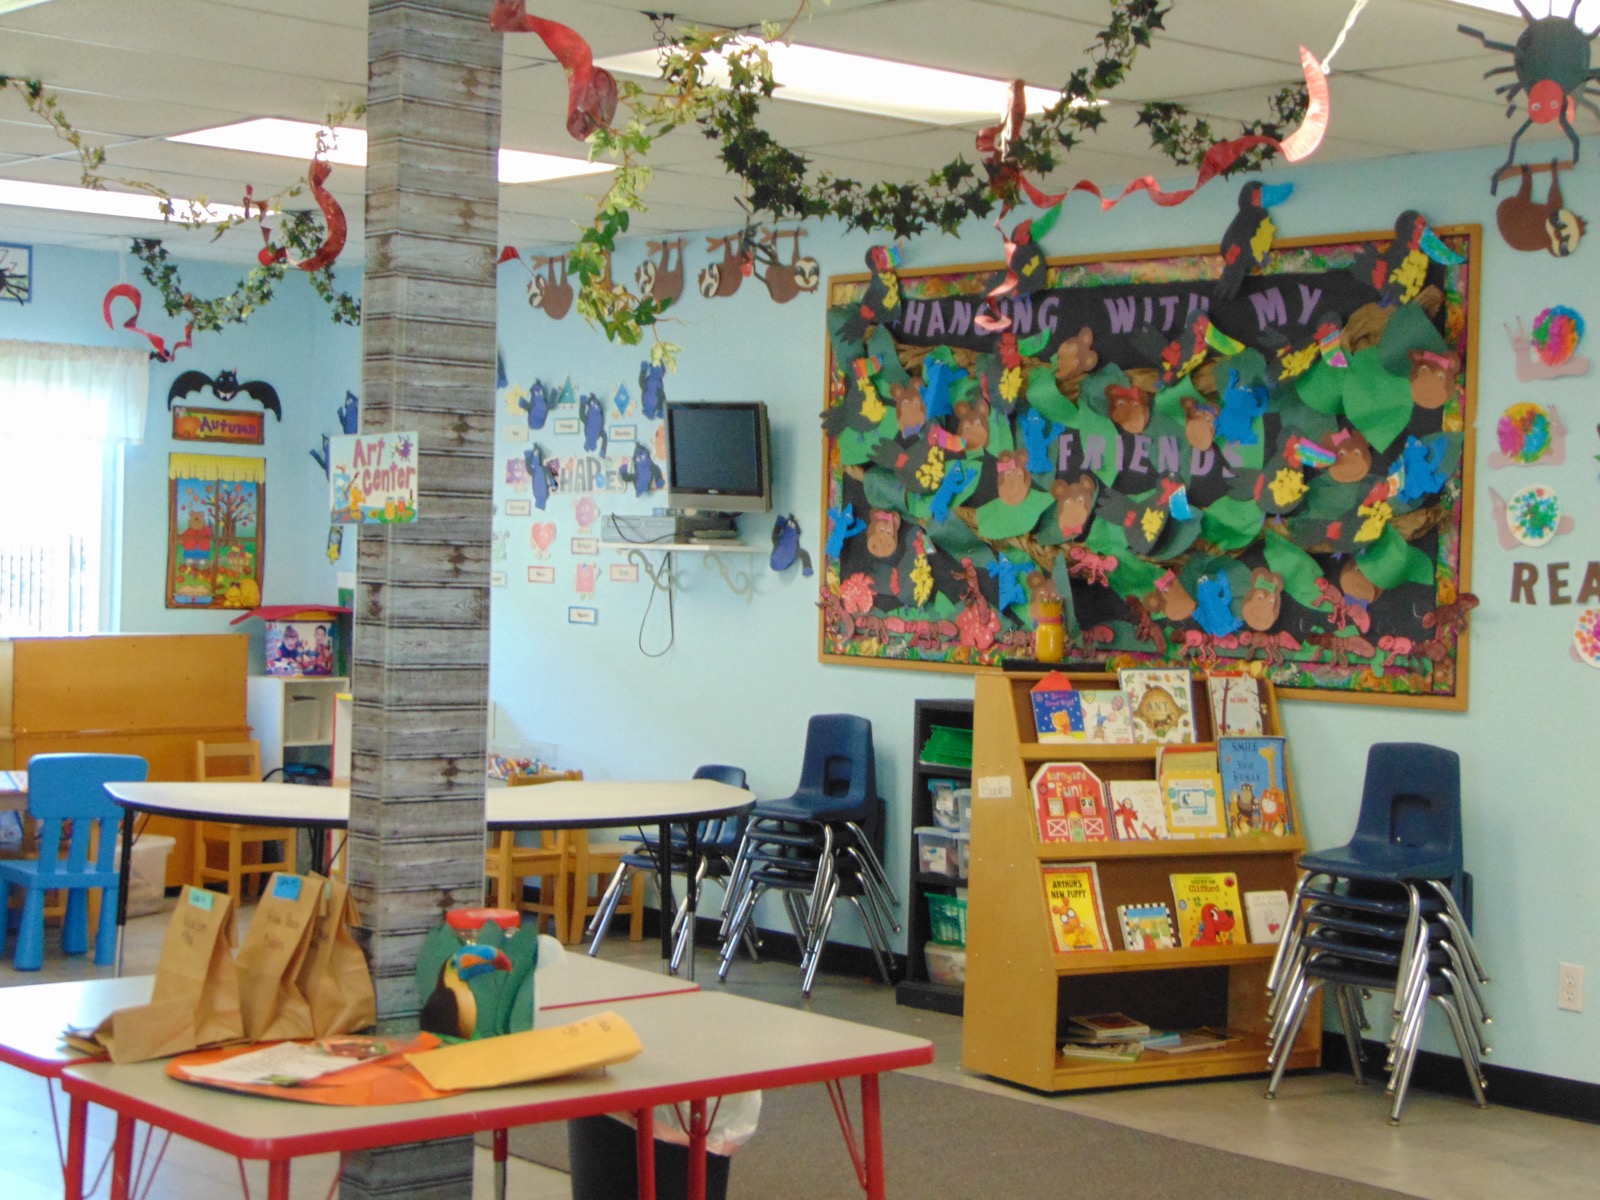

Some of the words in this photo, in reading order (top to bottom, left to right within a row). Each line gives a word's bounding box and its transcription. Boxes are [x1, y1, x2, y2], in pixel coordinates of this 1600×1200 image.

[1250, 284, 1323, 332] MY
[200, 416, 257, 435] Autumn
[353, 437, 386, 469] Art
[1058, 433, 1244, 478] FRIENDS
[362, 461, 416, 496] Center
[1146, 700, 1169, 712] ANT
[1231, 742, 1259, 752] SMILE
[1046, 770, 1087, 783] Barnyard
[1055, 782, 1083, 798] Fun!
[1052, 879, 1082, 889] ARTHUR'S
[1188, 885, 1220, 893] Clifford
[1050, 891, 1065, 899] NEW
[1067, 890, 1087, 899] PUPPY
